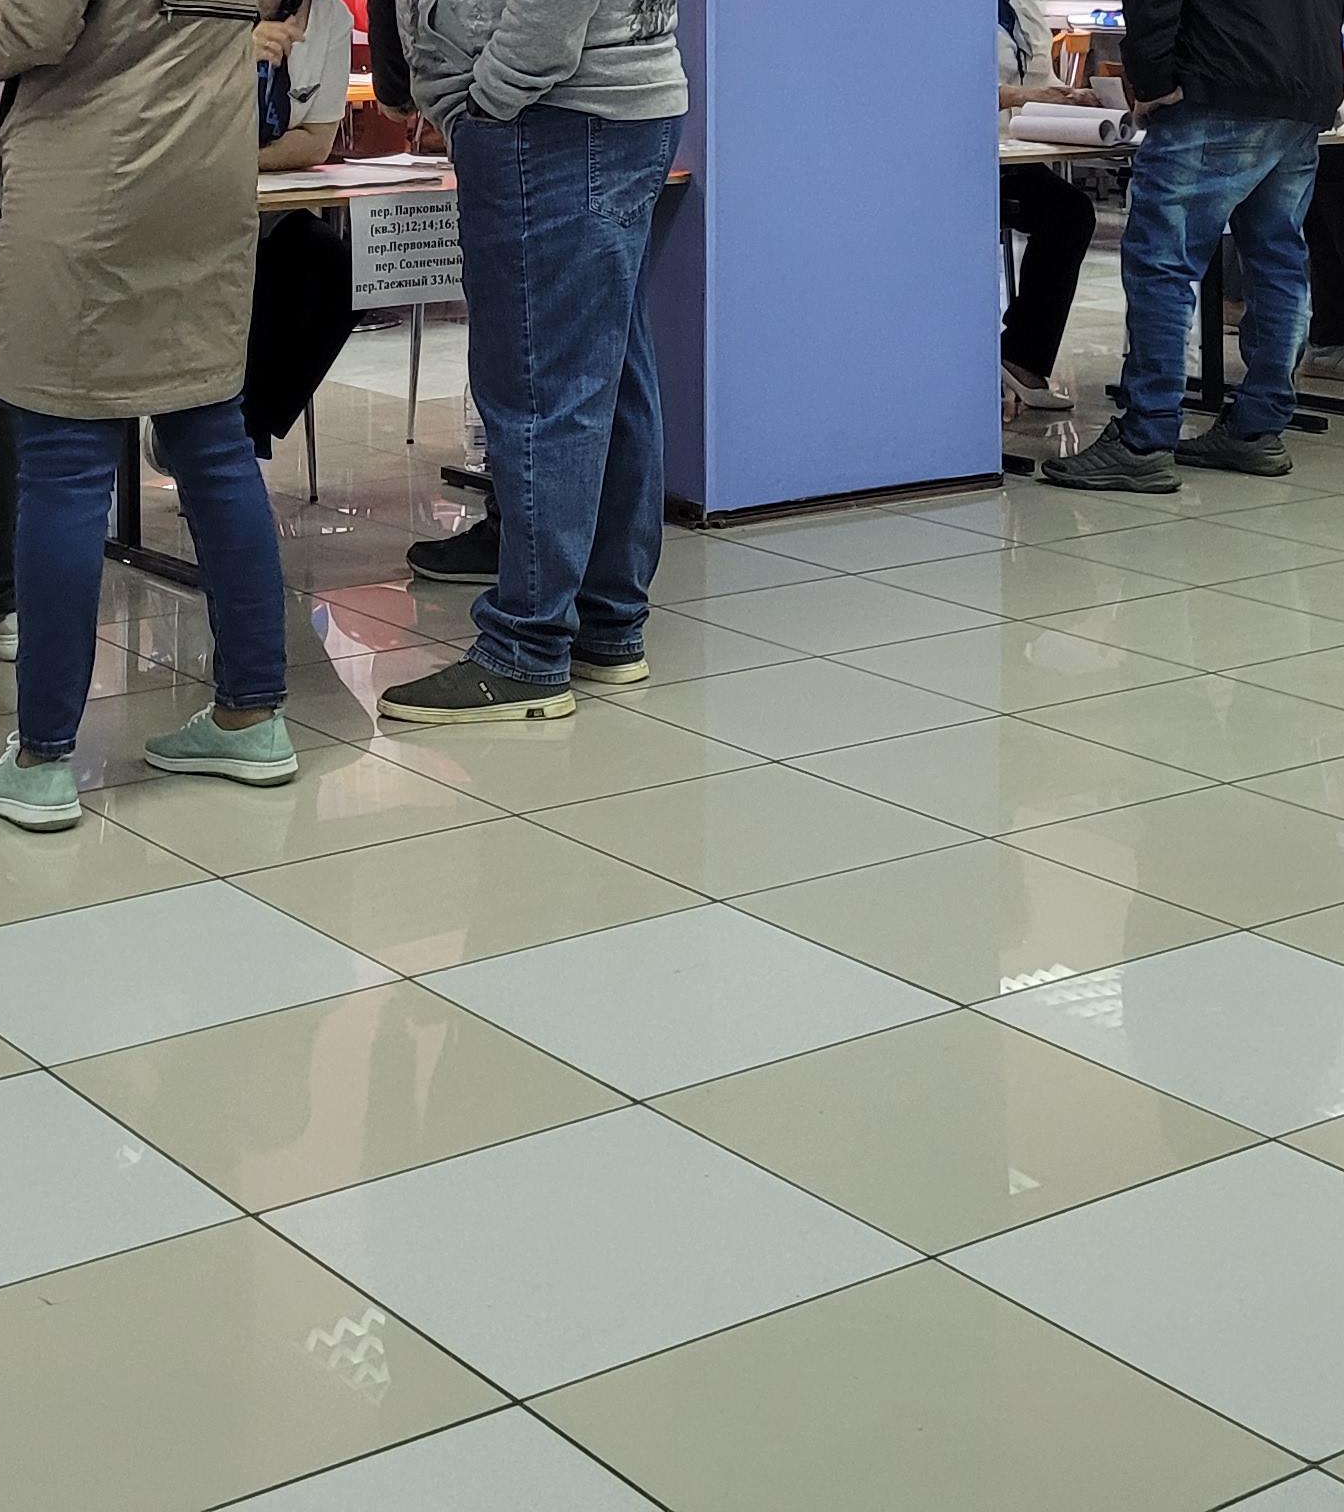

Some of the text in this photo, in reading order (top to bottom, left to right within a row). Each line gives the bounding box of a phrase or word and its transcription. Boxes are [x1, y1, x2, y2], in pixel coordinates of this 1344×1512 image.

[370, 201, 452, 219] пер. Парковый
[370, 219, 458, 237] (кв.3);12;14;16;
[375, 255, 462, 273] пер. Солнечный
[355, 276, 428, 294] пер.Таежный
